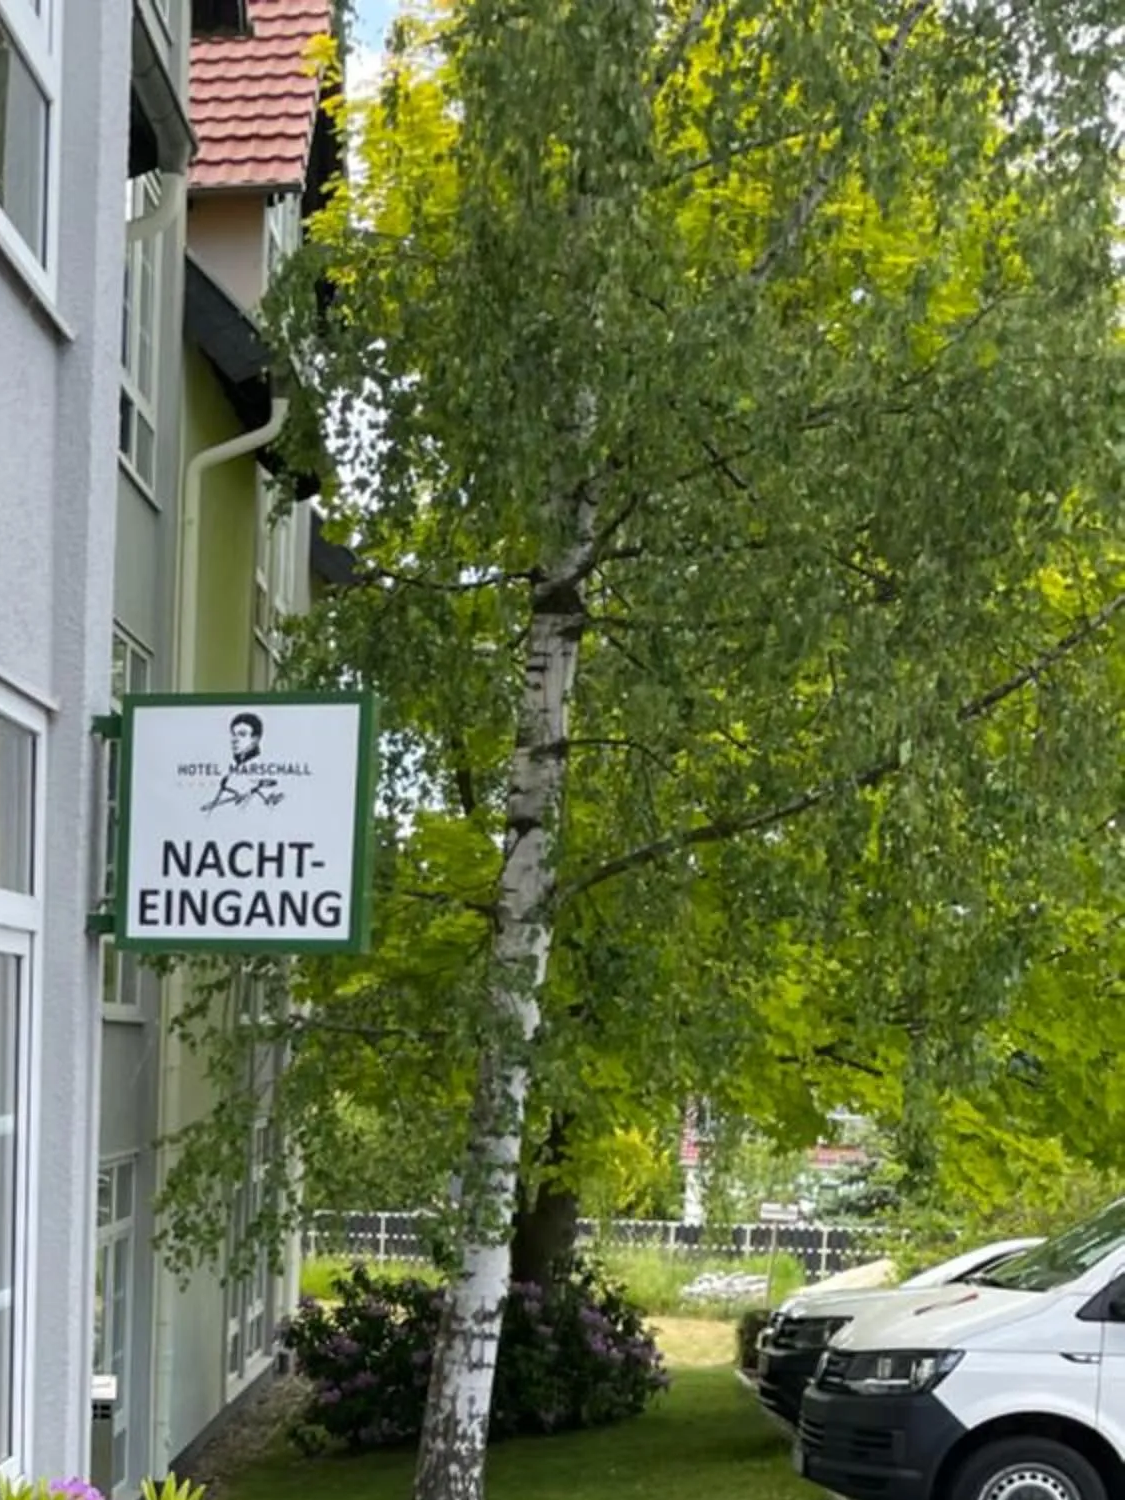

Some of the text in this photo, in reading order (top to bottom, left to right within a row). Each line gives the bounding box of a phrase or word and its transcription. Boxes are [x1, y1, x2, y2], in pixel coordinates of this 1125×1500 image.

[177, 762, 312, 776] HOTEL MARSCHALL
[161, 839, 326, 879] NACHT-
[138, 888, 343, 929] EINGANG
